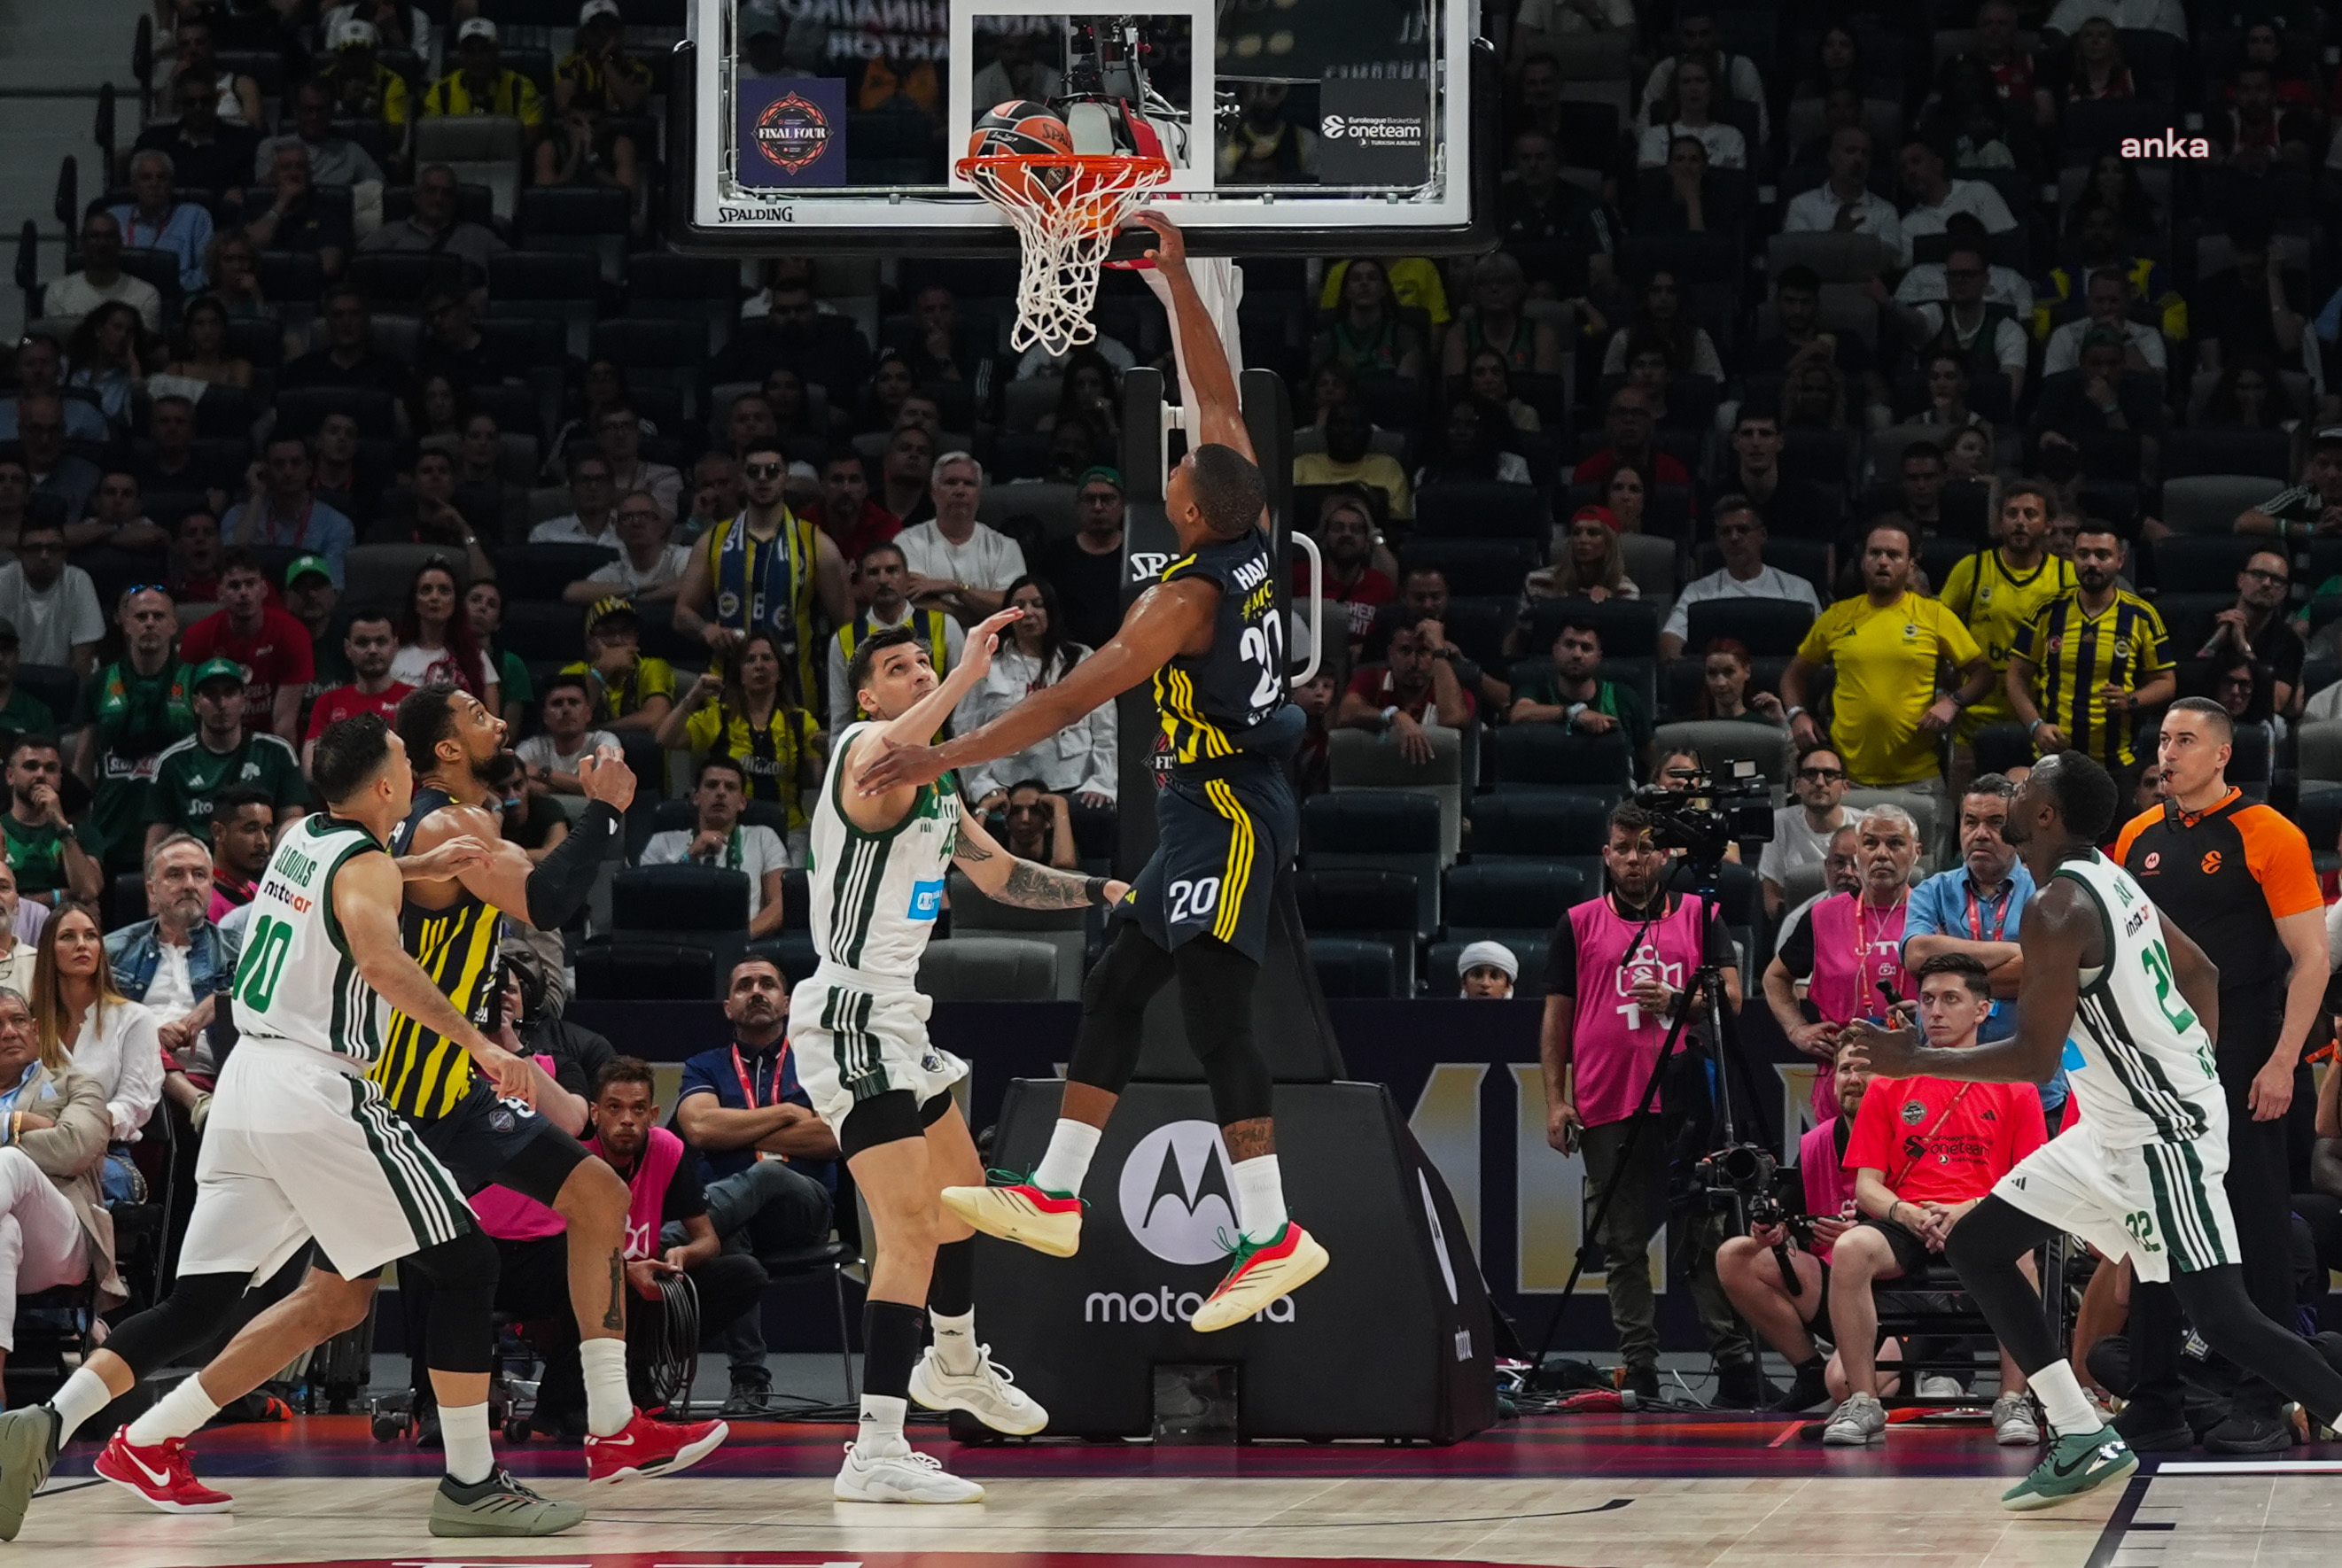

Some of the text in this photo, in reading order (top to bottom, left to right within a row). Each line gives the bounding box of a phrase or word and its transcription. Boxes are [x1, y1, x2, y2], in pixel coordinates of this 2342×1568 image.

[759, 127, 827, 140] FINAL FOUR
[1348, 124, 1421, 137] oneteam
[718, 206, 796, 223] SPALDING
[1239, 609, 1283, 709] 20
[263, 880, 312, 914] nstacar
[1168, 876, 1220, 924] 20
[231, 913, 293, 1014] 10
[1930, 1142, 1991, 1158] oneteam
[1085, 1285, 1295, 1323] motoa
